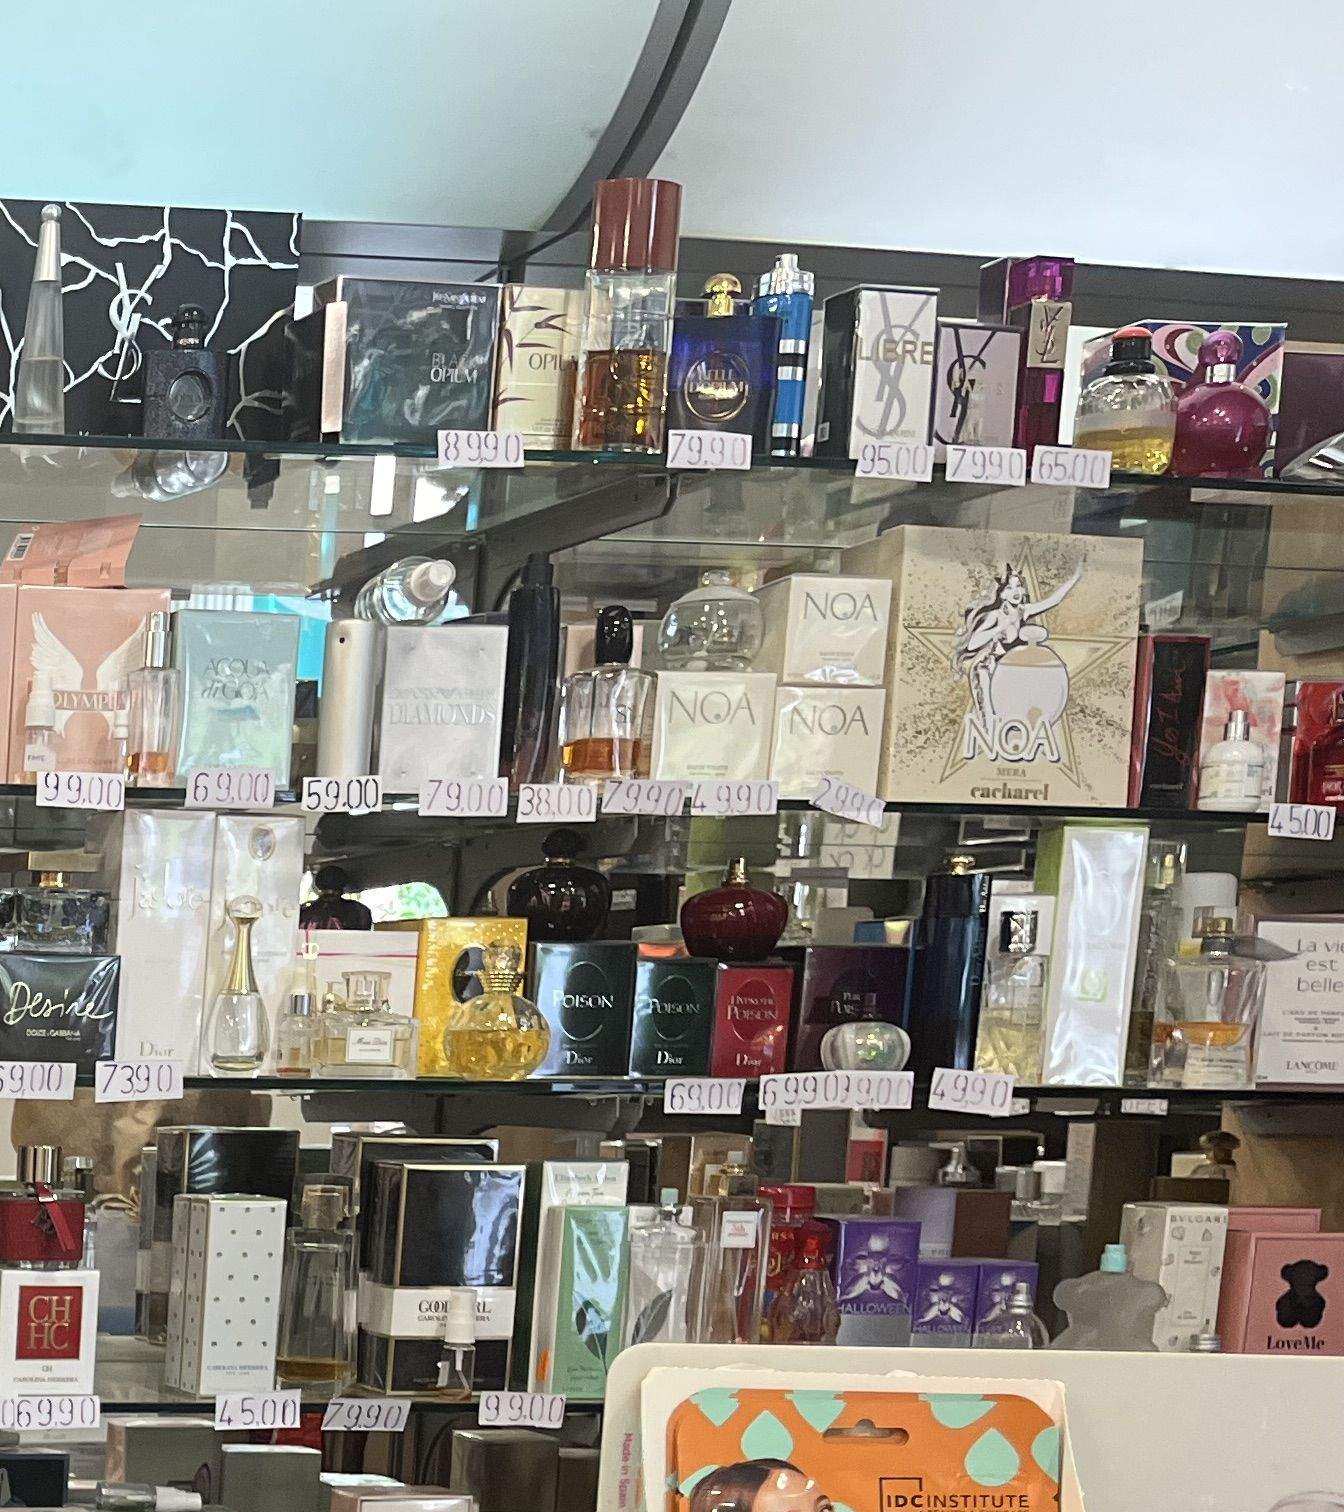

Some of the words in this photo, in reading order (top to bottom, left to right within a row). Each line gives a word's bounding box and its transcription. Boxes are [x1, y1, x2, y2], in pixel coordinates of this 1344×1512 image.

[803, 592, 880, 623] NOA
[668, 691, 755, 726] NOA
[788, 706, 868, 737] NOA
[962, 714, 1060, 764] NOA
[970, 785, 1050, 801] cacharel
[1267, 1335, 1324, 1350] LoveMe
[886, 1494, 923, 1508] IDC
[927, 1494, 1030, 1508] INSTITUTE
